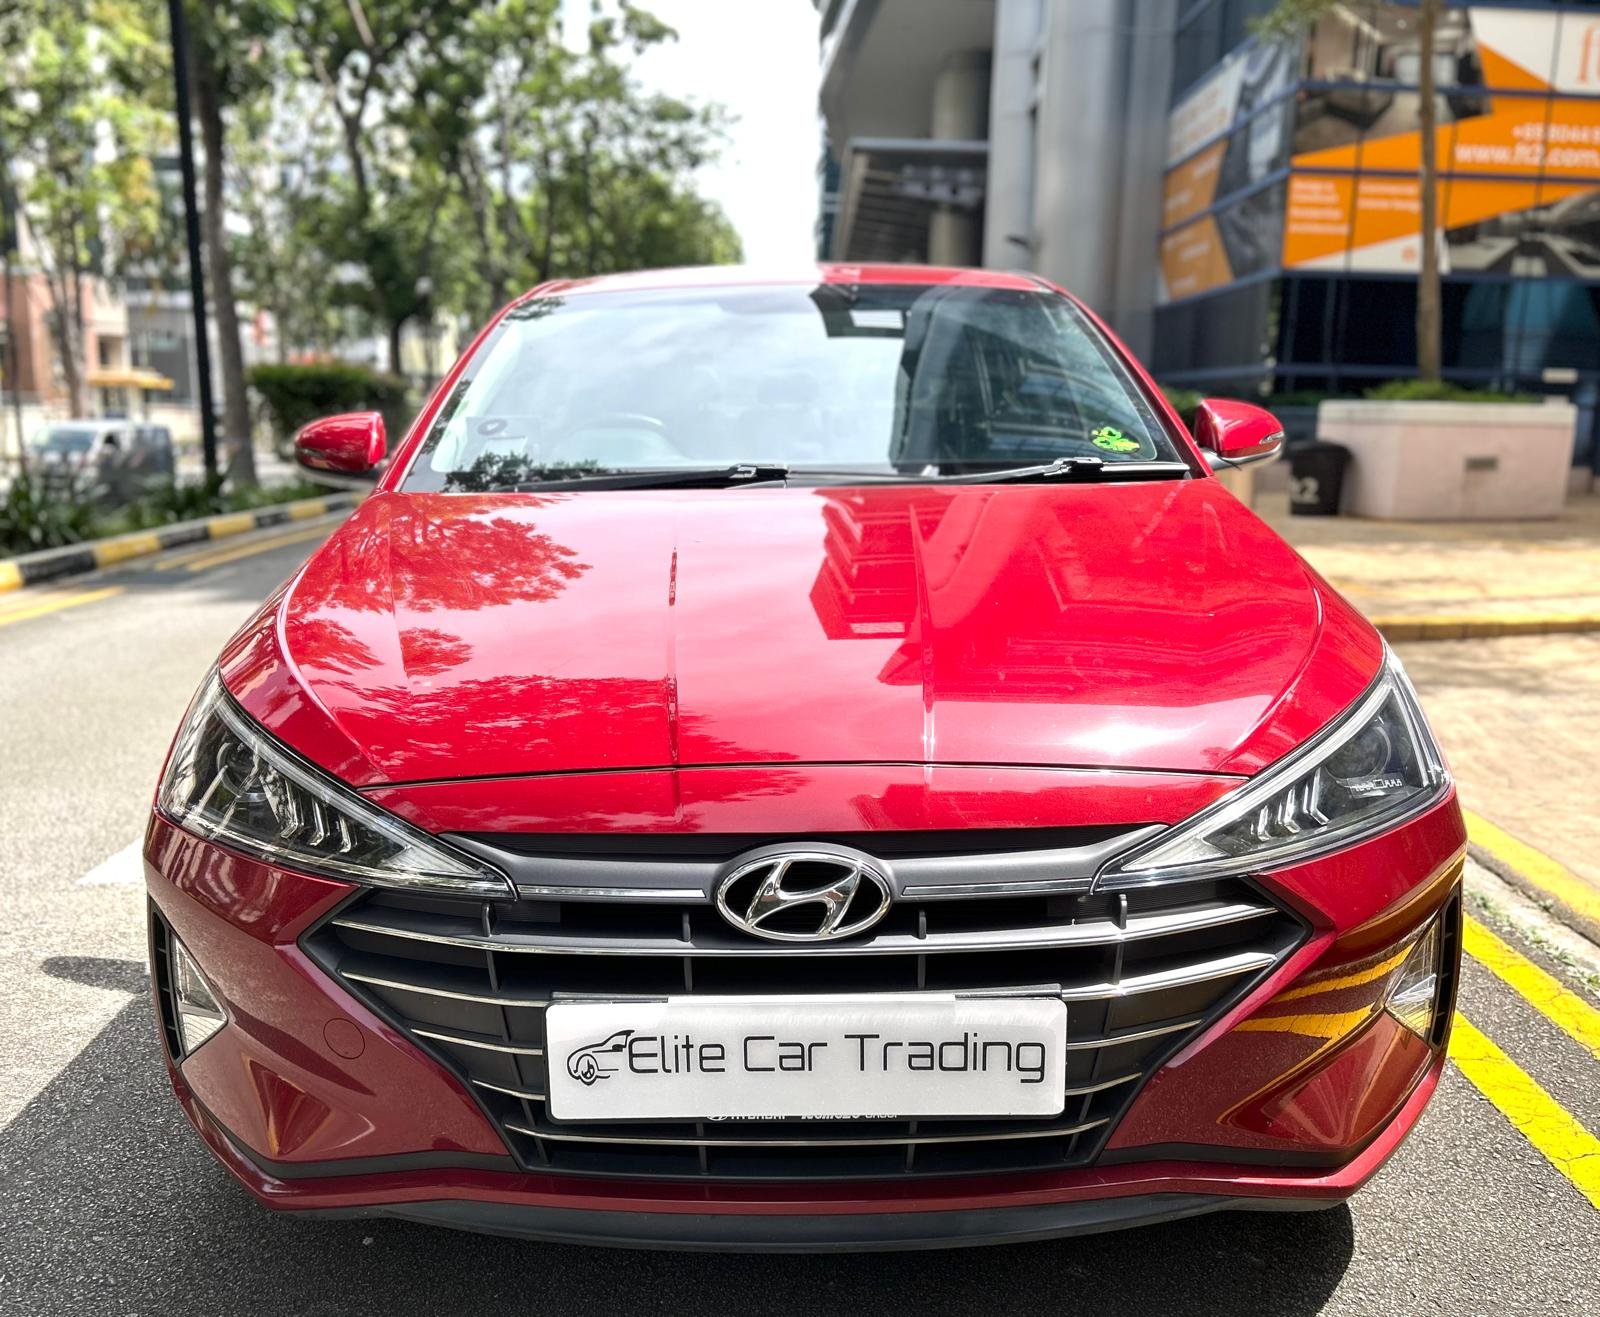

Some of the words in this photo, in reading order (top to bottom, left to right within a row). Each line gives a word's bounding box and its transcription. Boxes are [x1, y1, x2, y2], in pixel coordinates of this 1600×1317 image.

[628, 1034, 726, 1074] Elite
[743, 1034, 828, 1073] Car
[844, 1032, 1046, 1084] Trading
